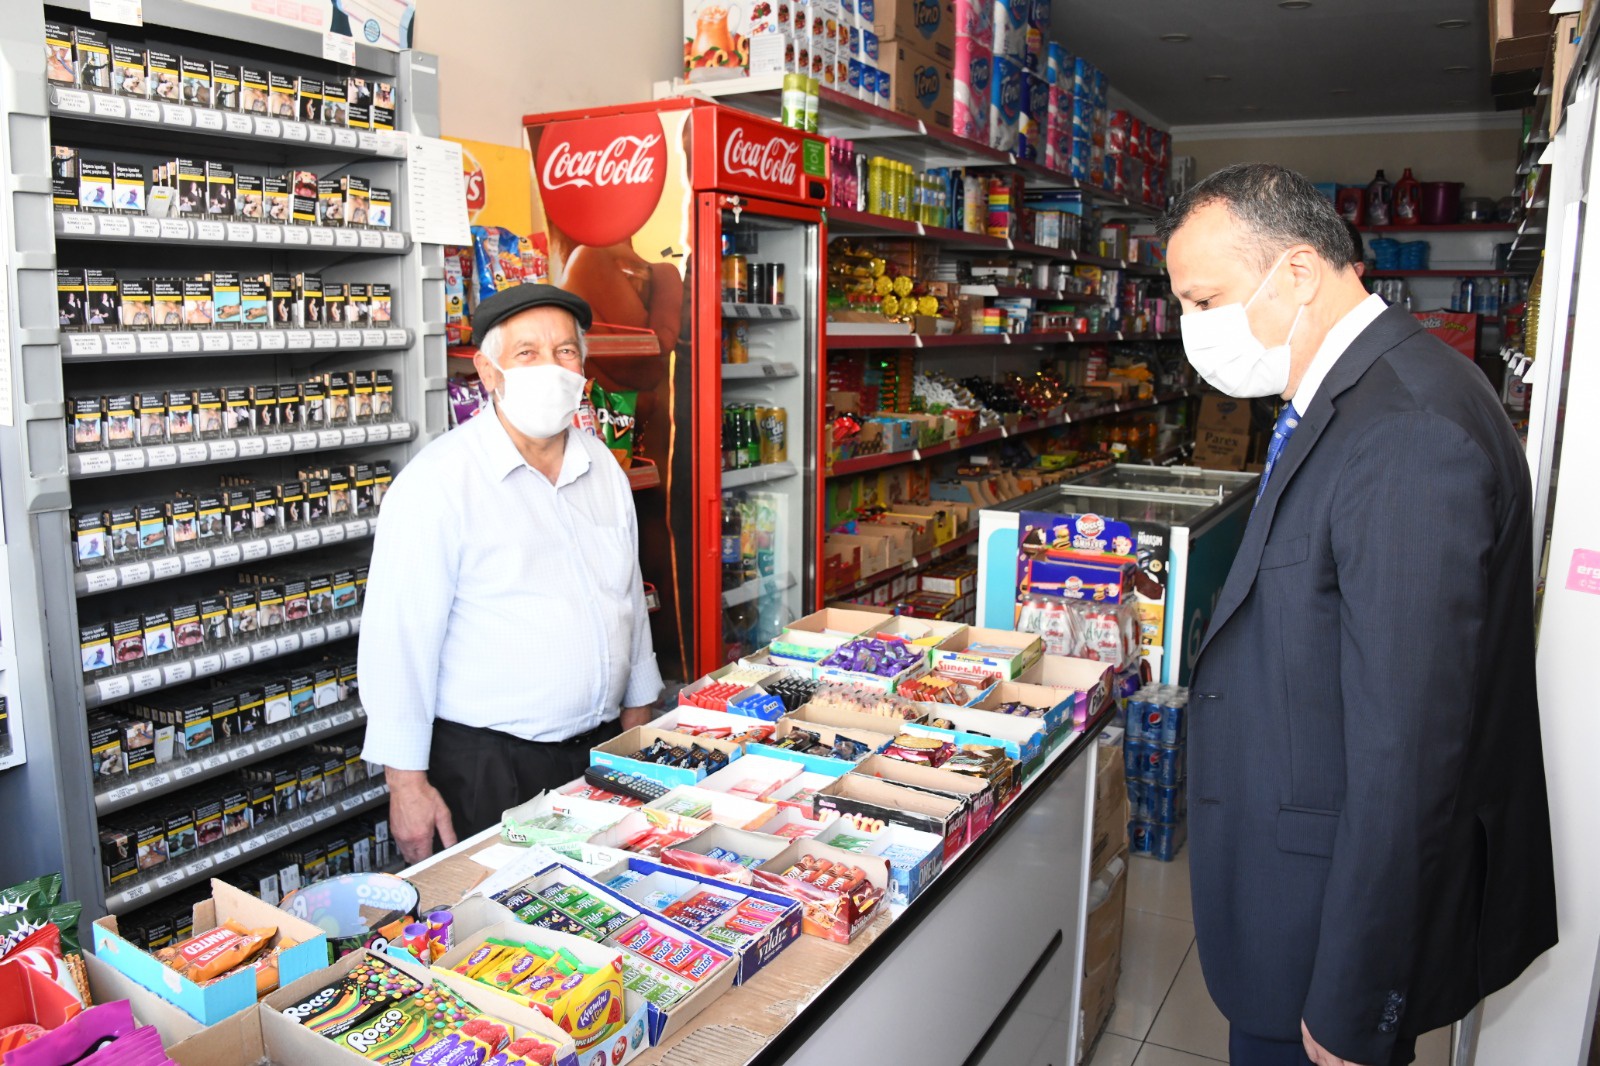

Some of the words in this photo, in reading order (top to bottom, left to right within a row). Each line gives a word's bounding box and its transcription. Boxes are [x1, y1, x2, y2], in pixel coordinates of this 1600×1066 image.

[914, 65, 939, 100] Teno
[542, 133, 662, 190] Coca-Cola
[723, 127, 799, 185] Coca-Cola
[1204, 431, 1238, 448] Parex
[184, 926, 237, 955] WANTED
[670, 942, 692, 966] Nazar
[691, 954, 713, 978] Nazar
